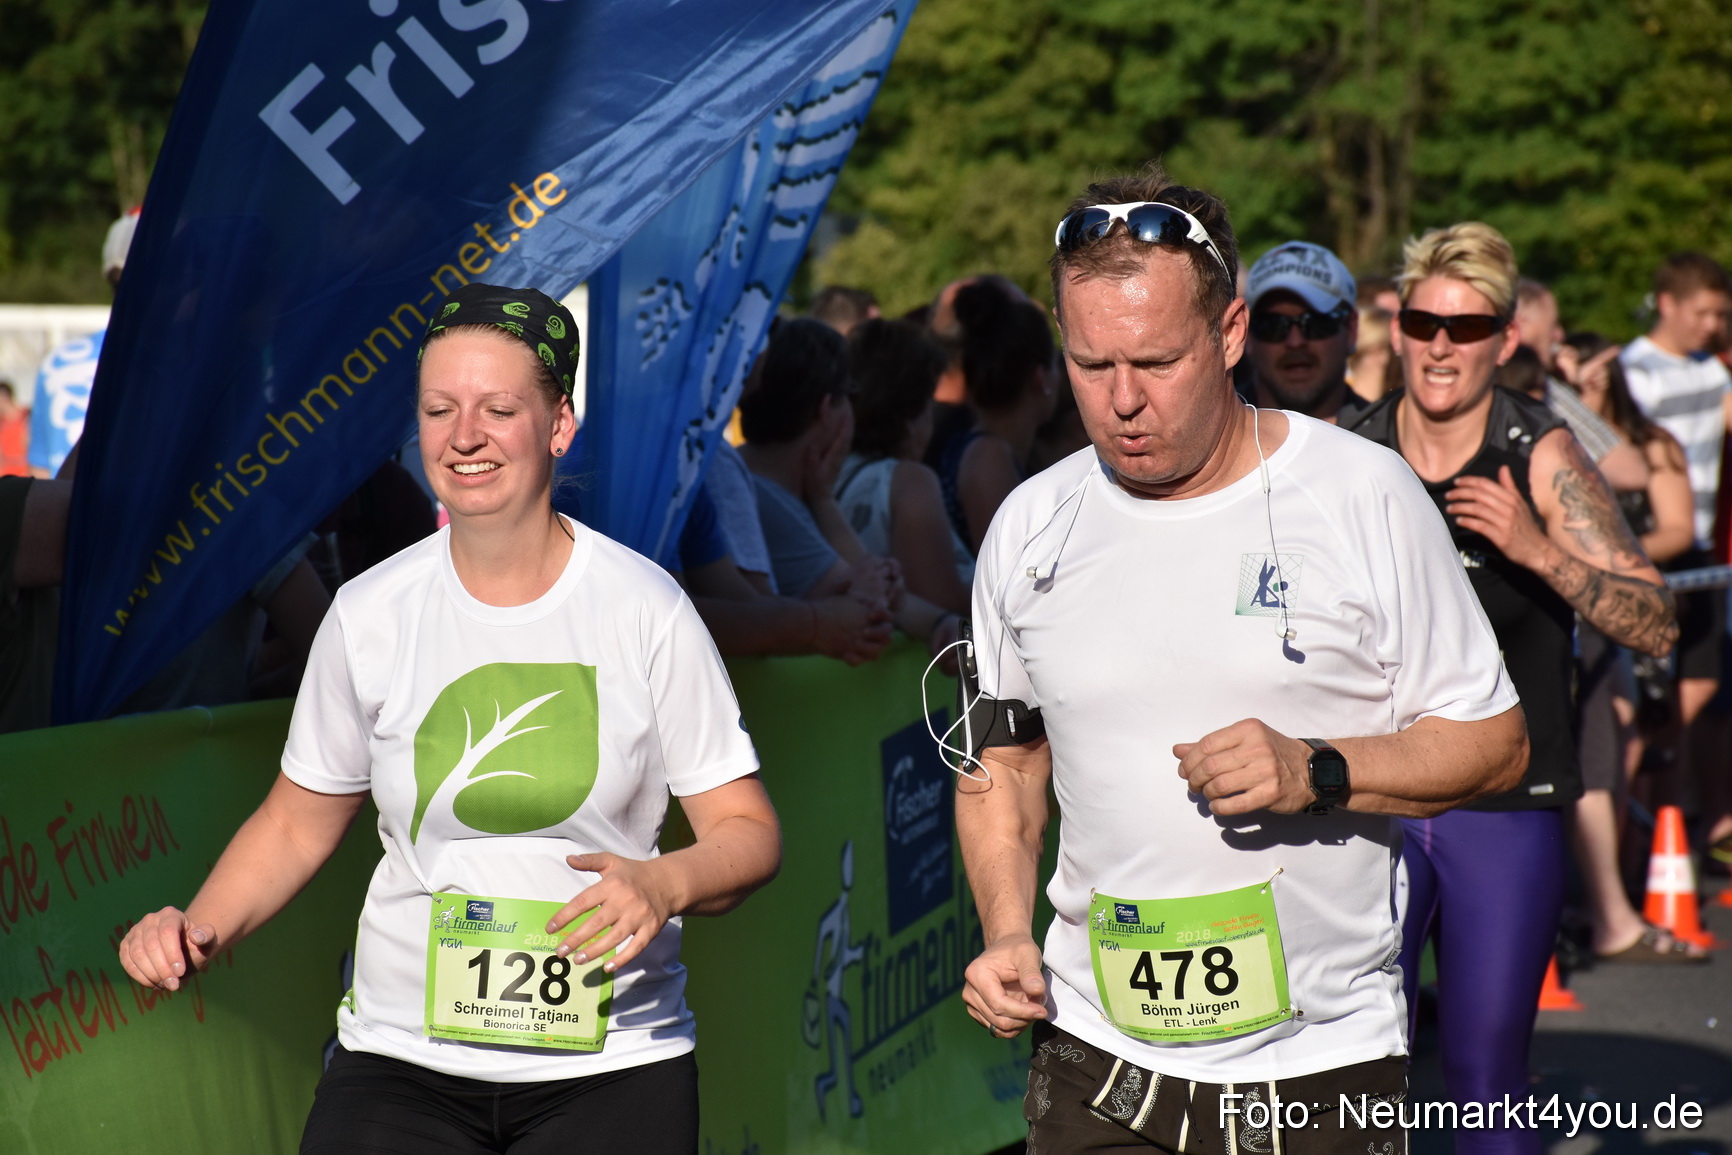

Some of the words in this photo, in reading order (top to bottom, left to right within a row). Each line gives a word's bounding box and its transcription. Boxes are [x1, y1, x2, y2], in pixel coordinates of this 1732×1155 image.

[47, 793, 181, 901] Firmen
[453, 917, 518, 933] firmenlauf
[1107, 919, 1165, 934] firmenlauf
[524, 934, 558, 947] 2018
[1176, 929, 1211, 943] 2018
[468, 949, 571, 1006] 128
[1129, 946, 1239, 1001] 478
[0, 946, 129, 1079] laufen
[454, 1001, 524, 1019] Schreimel
[529, 1007, 579, 1024] Tatjana
[1141, 1002, 1184, 1017] Böhm
[1187, 999, 1240, 1018] Jürgen
[483, 1019, 530, 1032] Bionorica
[533, 1022, 547, 1032] SE
[1164, 1018, 1184, 1028] ETL
[1192, 1017, 1217, 1027] Lenk
